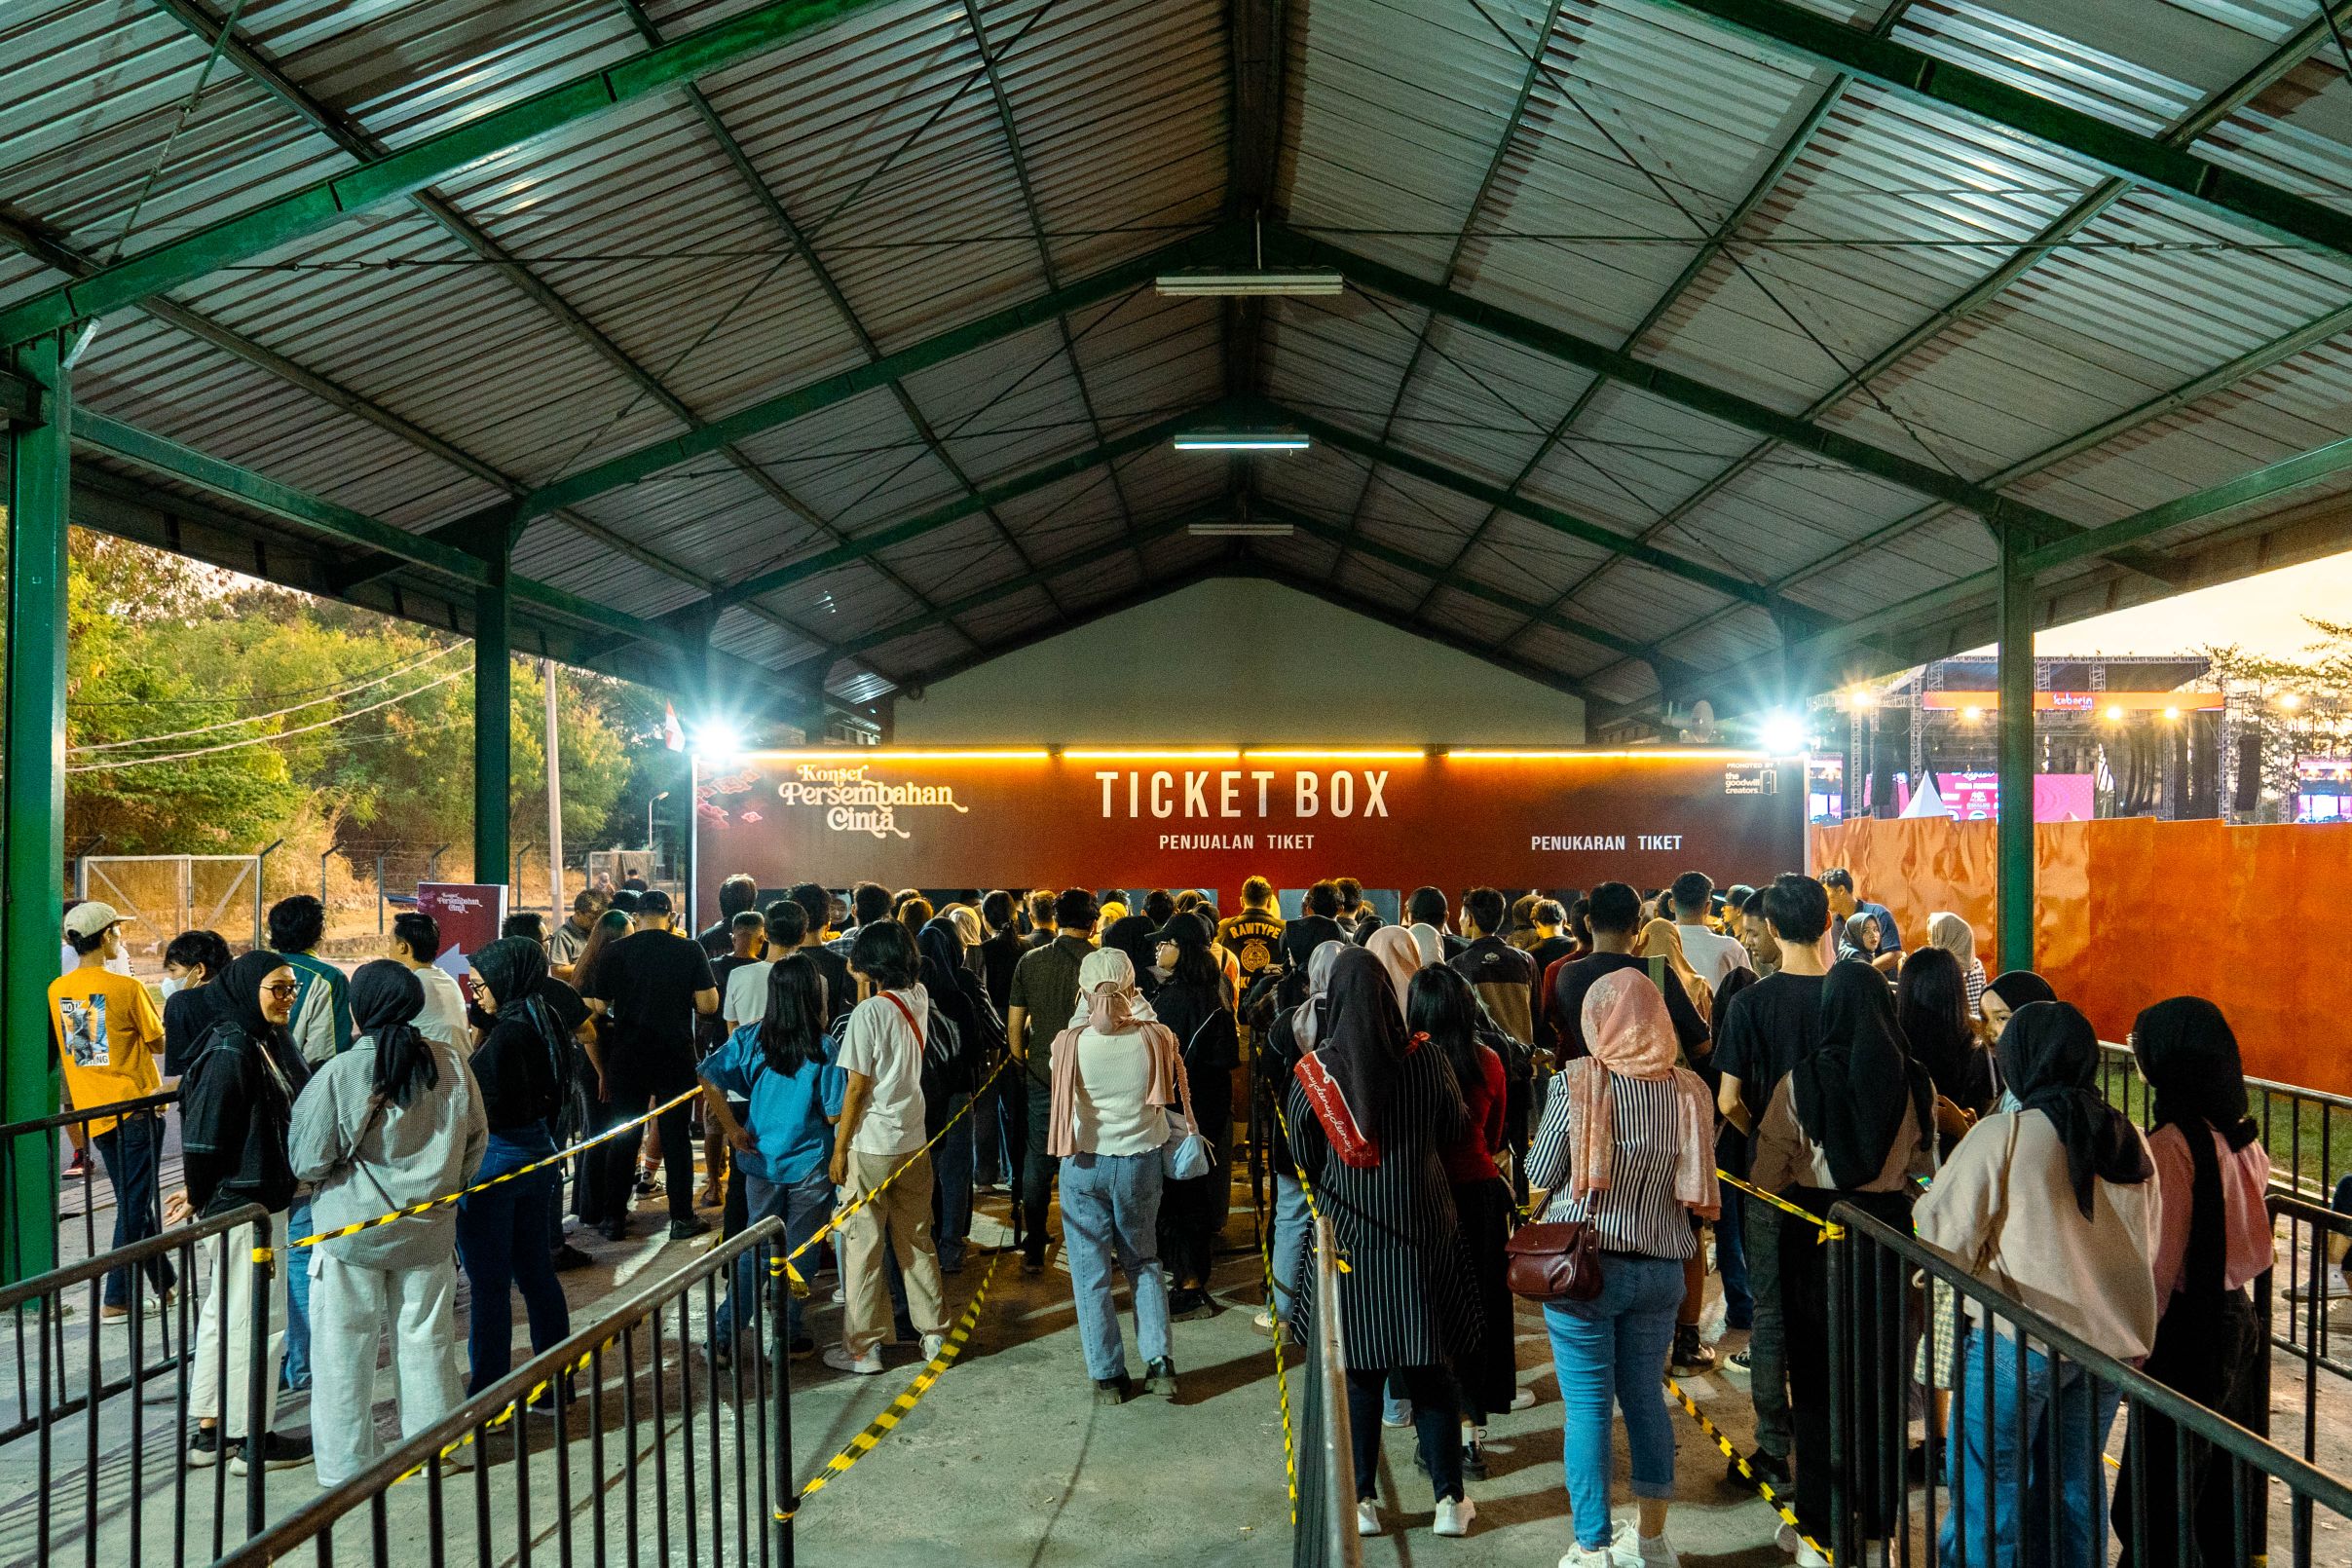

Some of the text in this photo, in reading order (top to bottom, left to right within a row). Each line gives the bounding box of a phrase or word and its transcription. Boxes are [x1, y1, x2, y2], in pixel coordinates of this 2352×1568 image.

[797, 764, 869, 785] Konser
[1725, 779, 1760, 788] goodwill
[779, 780, 968, 812] Persembahan
[1096, 770, 1389, 818] TICKET BOX
[827, 806, 910, 839] Cinta
[1159, 835, 1315, 850] PENJUALAN TIKET
[1531, 835, 1683, 851] PENUKARAN TIKET
[1229, 922, 1282, 939] RAWTYPE
